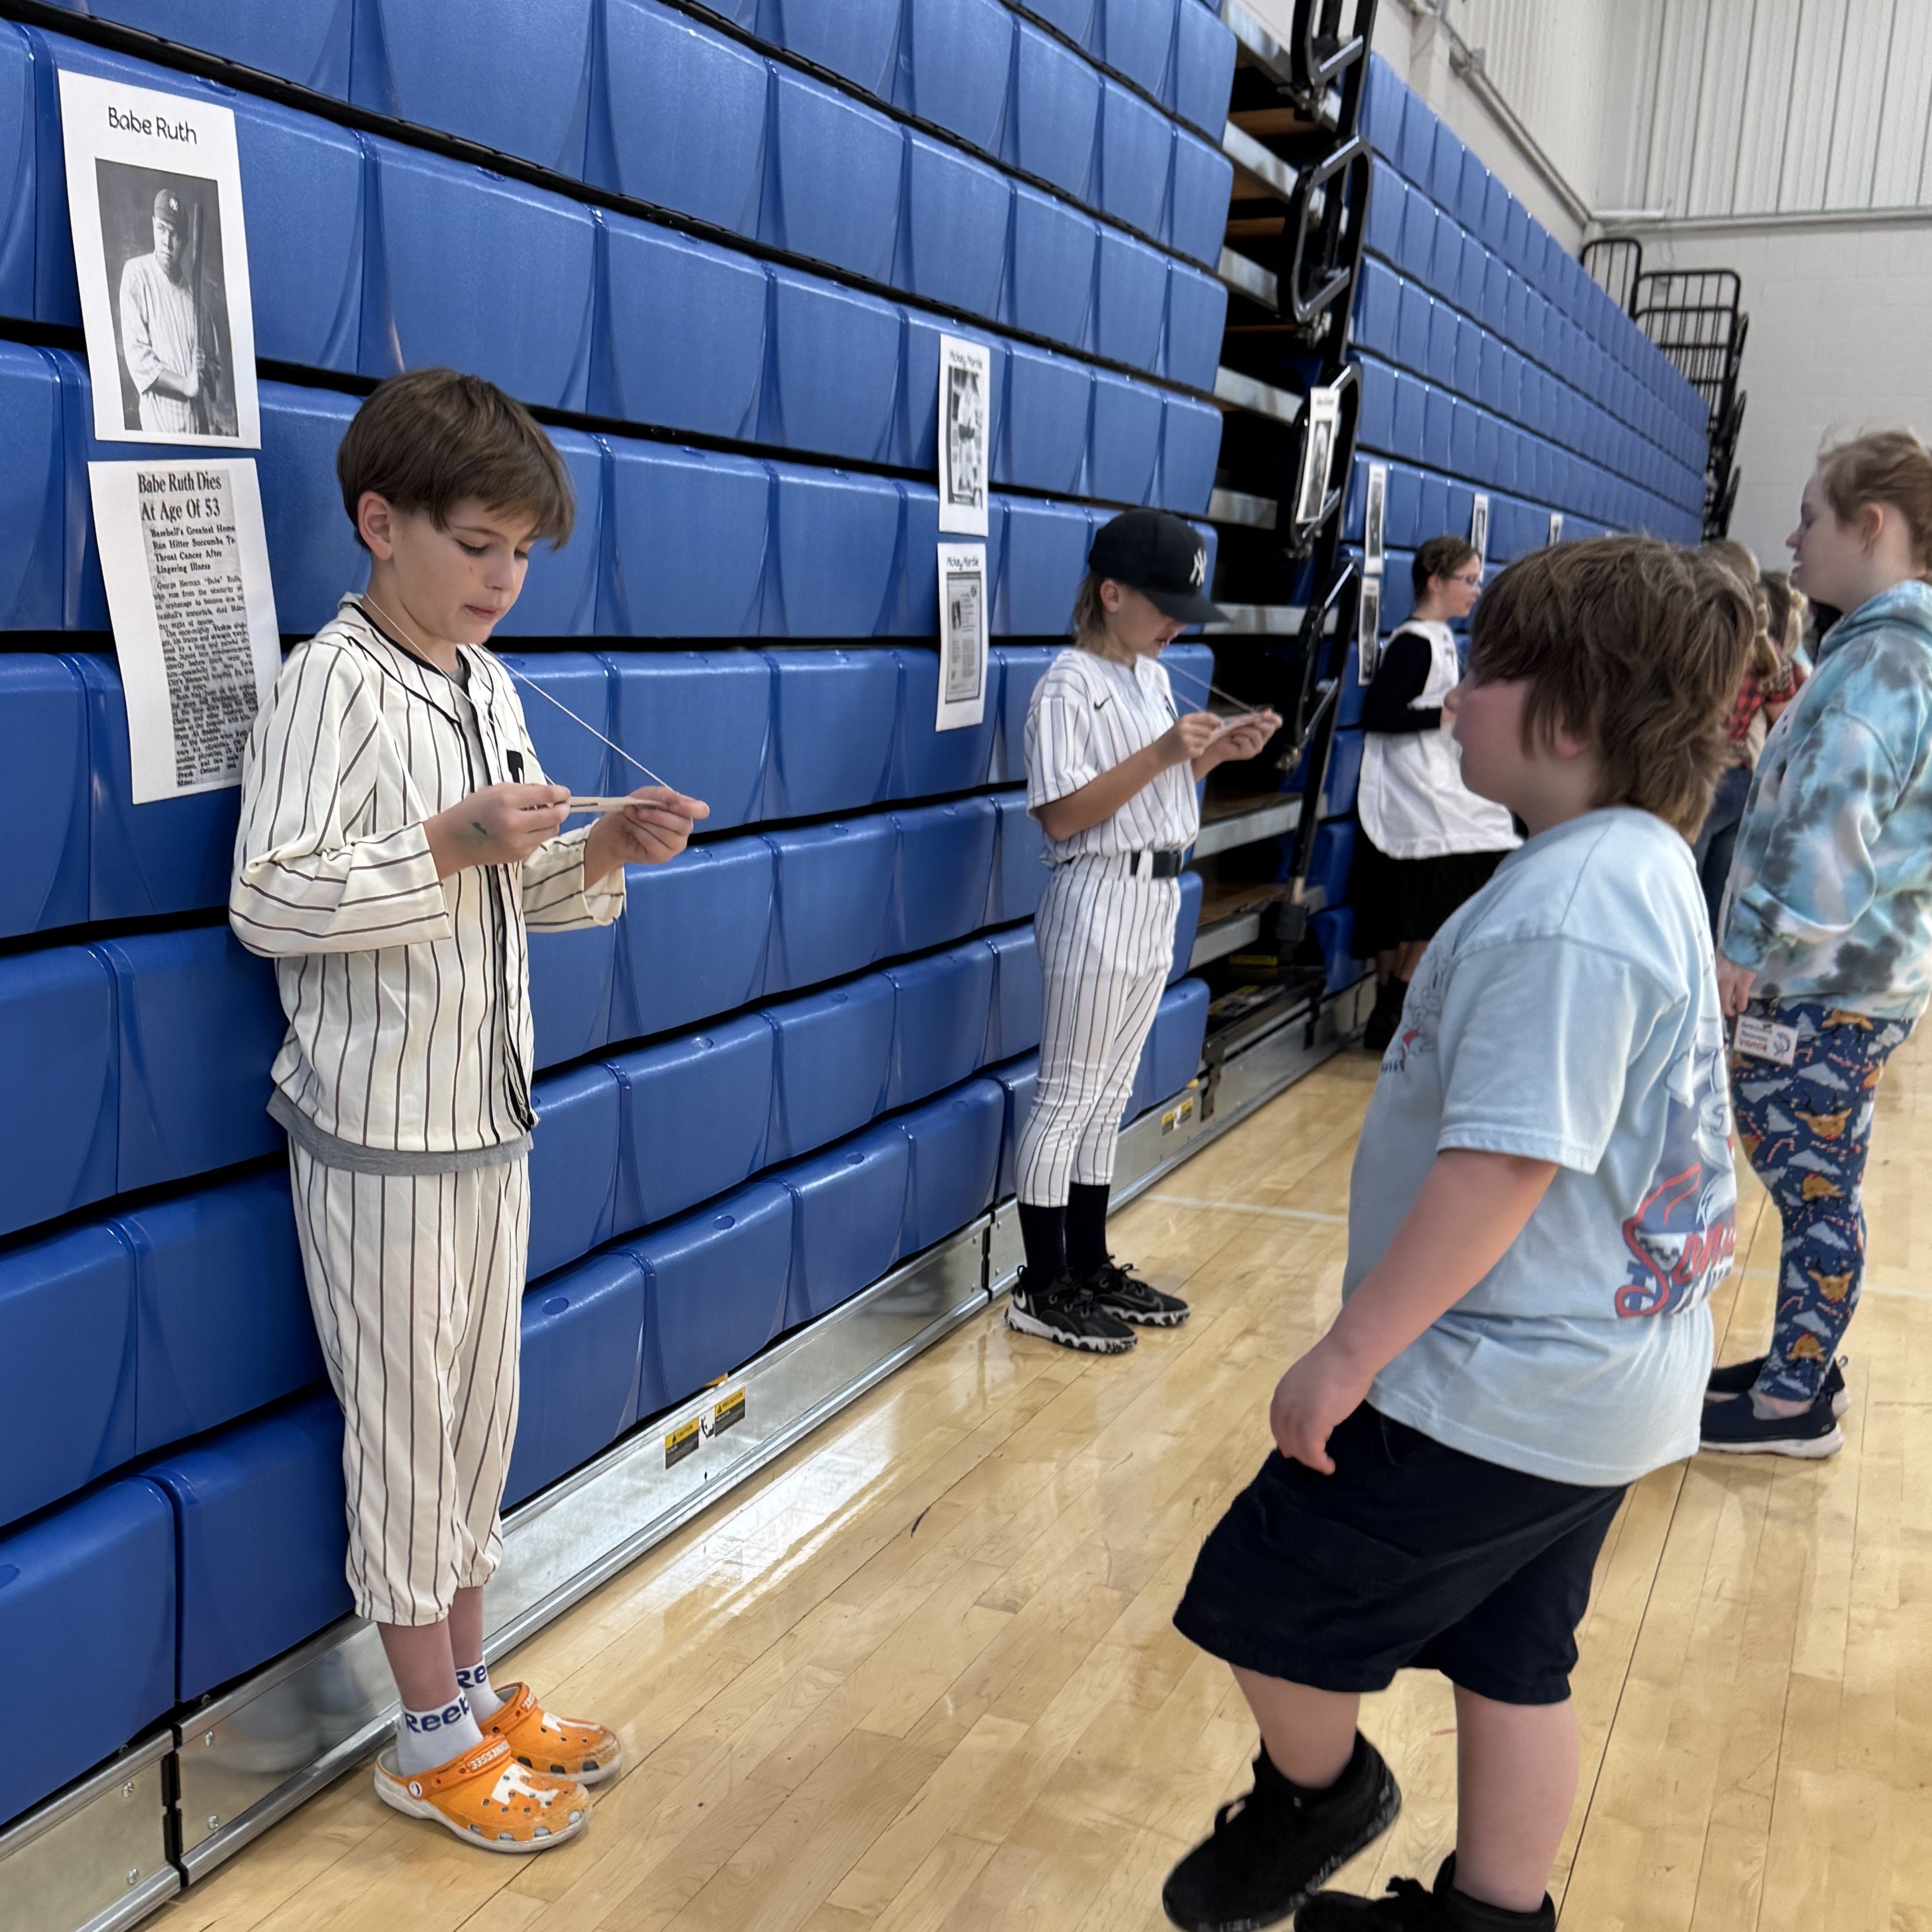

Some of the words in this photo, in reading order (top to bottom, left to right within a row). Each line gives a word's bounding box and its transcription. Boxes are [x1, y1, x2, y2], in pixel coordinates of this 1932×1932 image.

[108, 106, 152, 135] Babe
[156, 116, 197, 145] Ruth
[138, 474, 166, 494] Babe
[169, 473, 195, 492] Ruth
[197, 471, 222, 491] Dies
[141, 502, 156, 521] At
[160, 501, 182, 523] Age
[187, 498, 201, 519] Of
[205, 498, 220, 517] 53
[150, 527, 184, 537] Baseball's
[187, 526, 214, 536] Greatest
[216, 524, 236, 533] Home
[153, 541, 166, 550] Run
[169, 540, 189, 549] Hitter
[192, 537, 223, 547] Succumbs
[155, 553, 177, 562] Throat
[180, 551, 202, 560] Cancer
[206, 548, 222, 558] After
[156, 564, 187, 574] Lingering
[190, 562, 211, 571] Illness
[456, 1665, 487, 1688] Re
